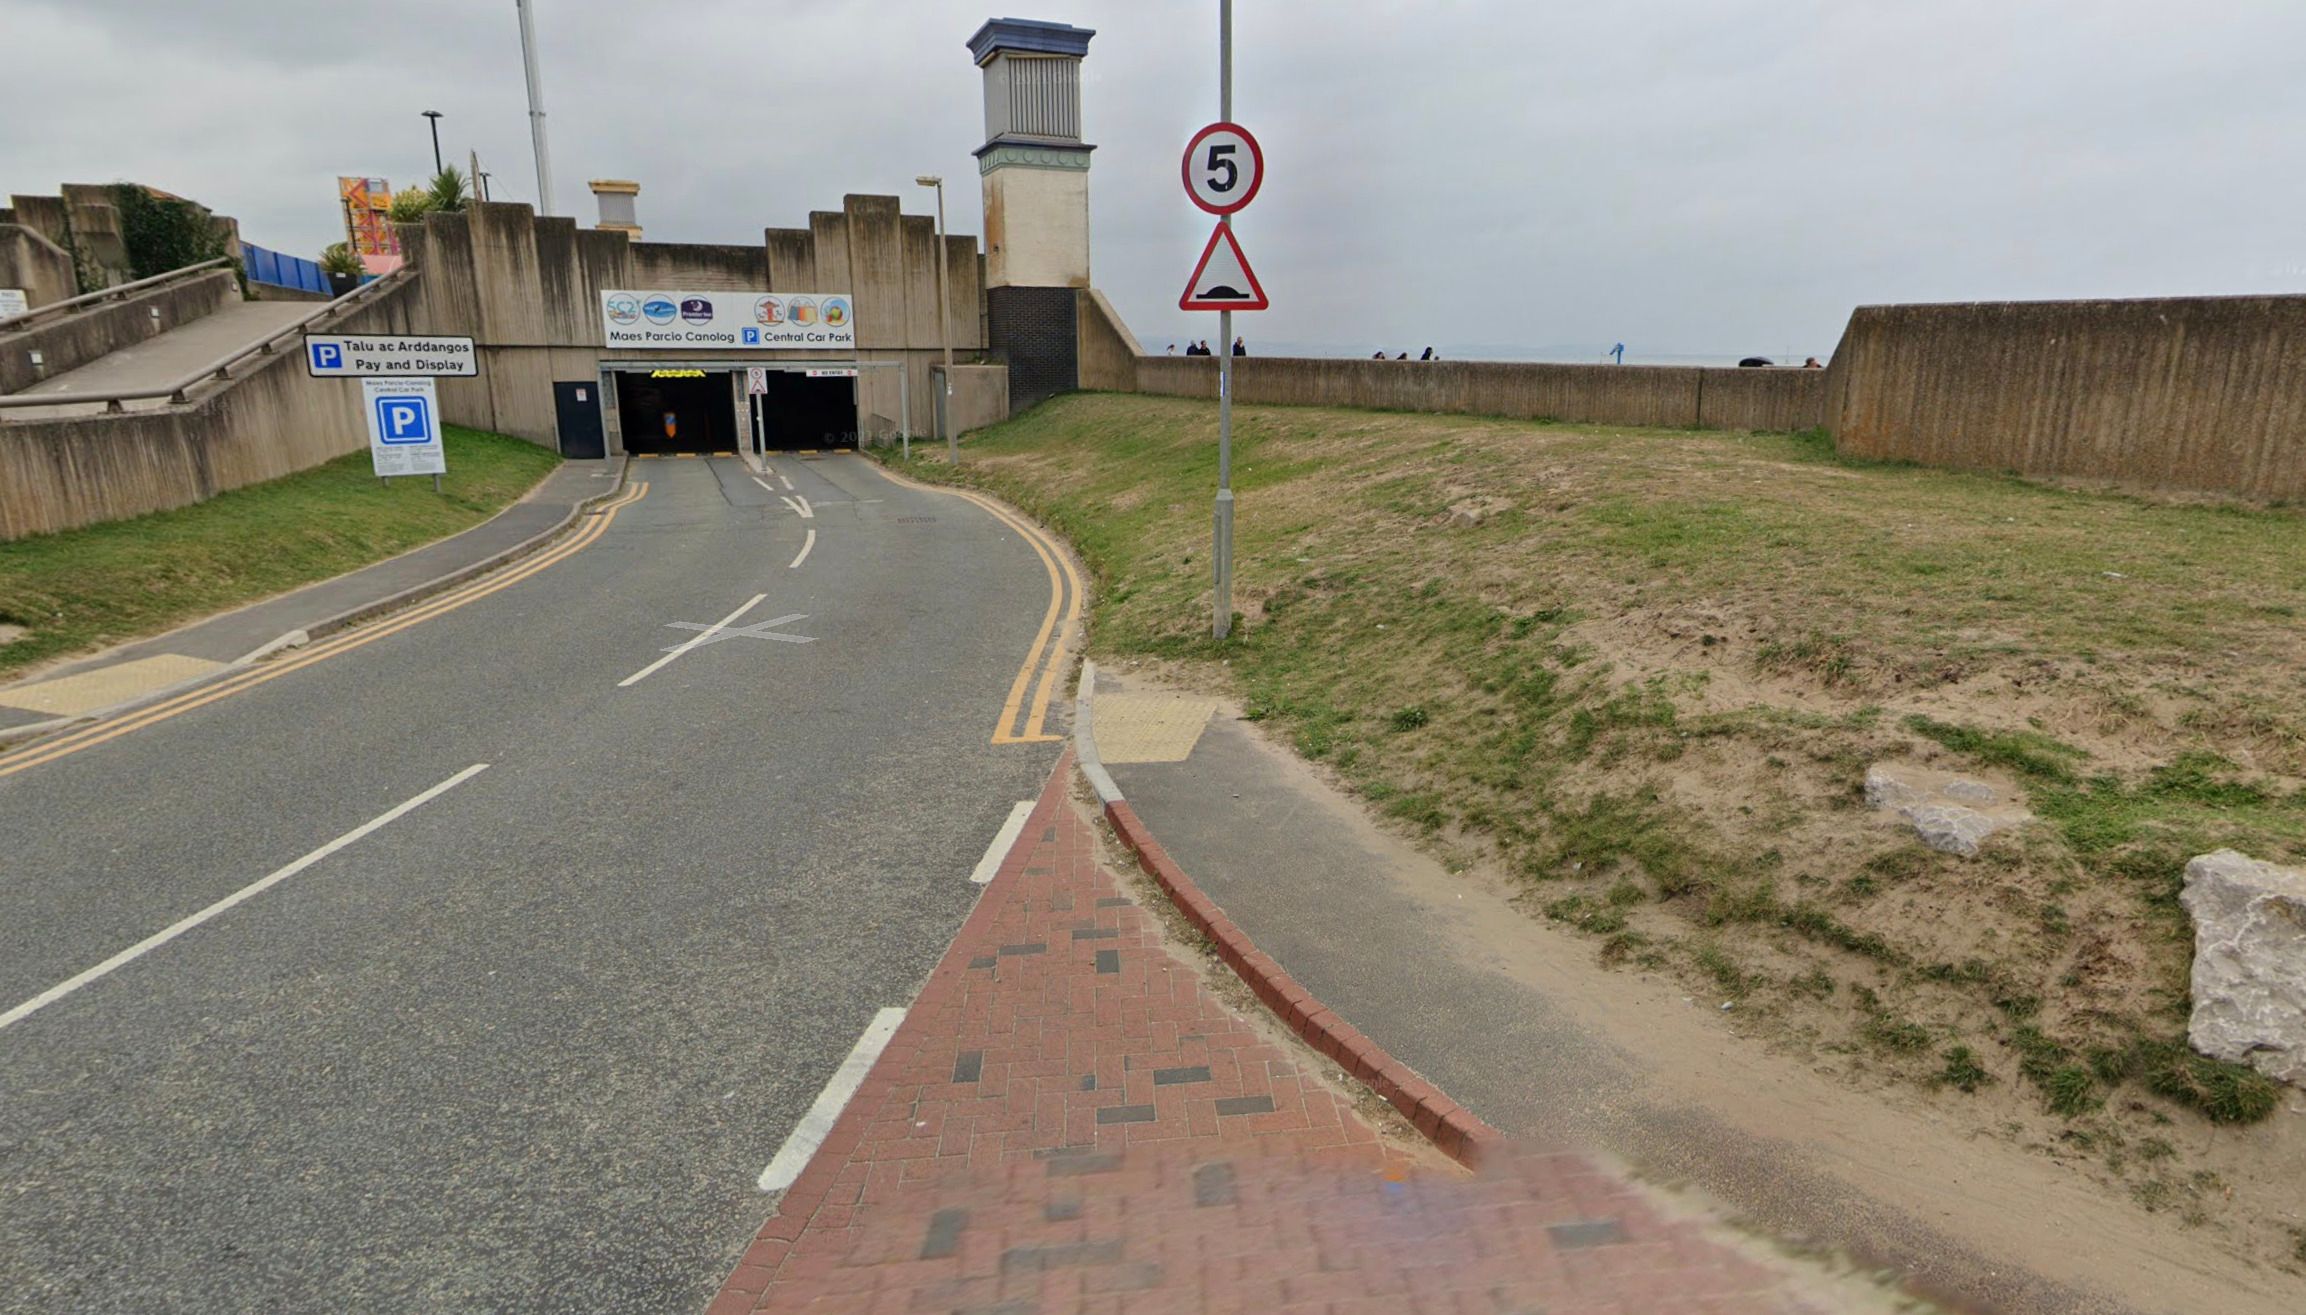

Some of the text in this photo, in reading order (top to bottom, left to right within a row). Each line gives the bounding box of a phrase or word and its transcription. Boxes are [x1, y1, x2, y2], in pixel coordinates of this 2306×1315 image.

[1207, 144, 1238, 193] 5
[610, 331, 735, 343] Maes Parcio Canolog
[764, 332, 852, 342] Central Car Park
[344, 340, 469, 354] Talu ac Arddangos
[318, 346, 337, 366] P
[356, 359, 464, 371] Pay and Display
[392, 407, 415, 434] P
